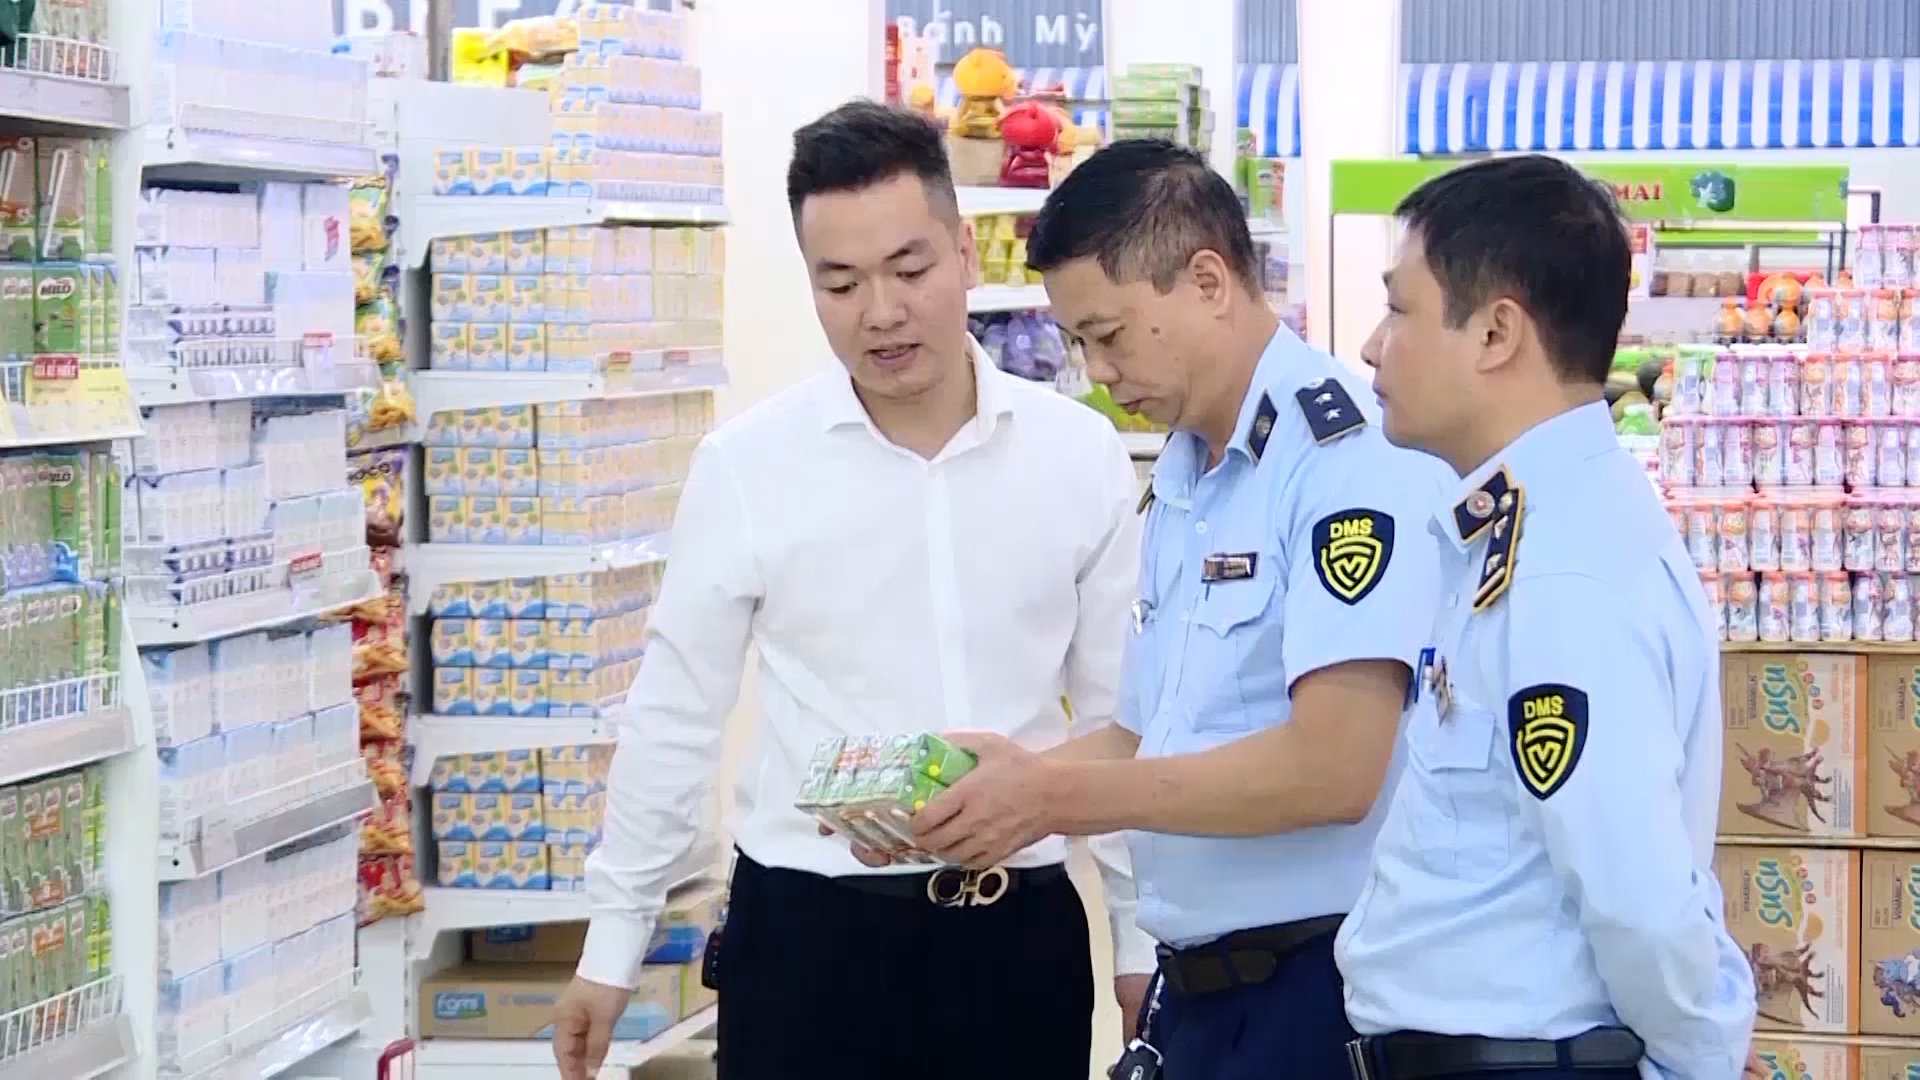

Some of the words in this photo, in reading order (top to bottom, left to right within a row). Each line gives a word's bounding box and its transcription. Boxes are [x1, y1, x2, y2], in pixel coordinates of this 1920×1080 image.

[896, 10, 1003, 45] Bánh
[1329, 518, 1373, 539] DMS
[1523, 695, 1564, 719] DMS
